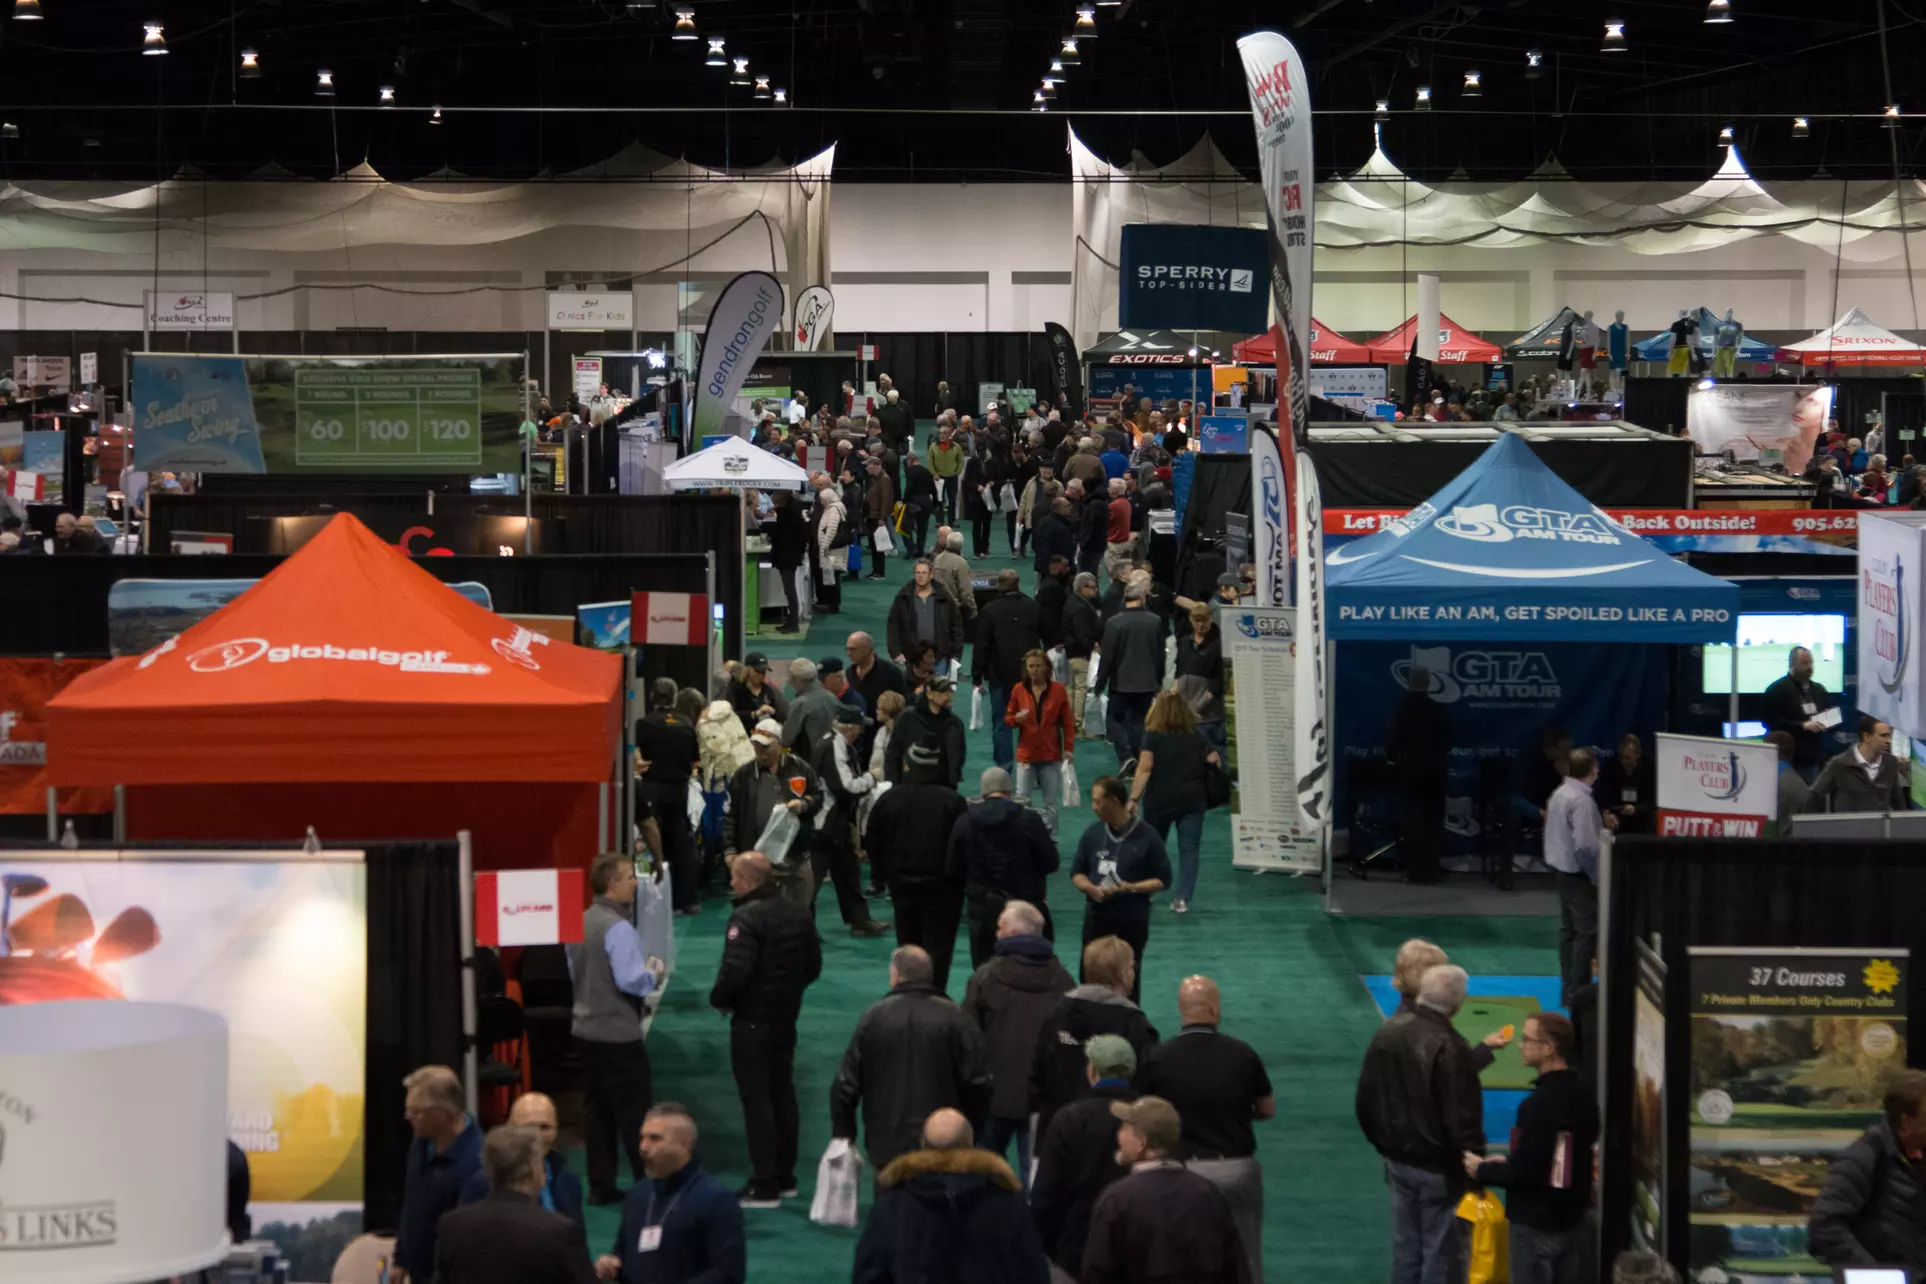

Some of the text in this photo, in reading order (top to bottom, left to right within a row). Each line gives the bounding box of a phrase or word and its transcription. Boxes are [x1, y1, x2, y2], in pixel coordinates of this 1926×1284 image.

[1138, 265, 1229, 280] SPERRY
[1138, 280, 1226, 291] TOP-SIDER
[150, 314, 232, 323] Coaching Centre
[556, 312, 585, 320] Clnics
[606, 312, 625, 320] Kids
[708, 286, 773, 398] gendrongolf
[1831, 335, 1897, 346] SRIXON
[1108, 354, 1185, 364] EXOTICS
[1440, 350, 1468, 362] Staff
[1343, 514, 1375, 529] Let
[1622, 514, 1673, 530] Back
[1674, 514, 1756, 530] Outside!
[1500, 505, 1613, 536] GTA
[1513, 527, 1621, 545] AM TOUR
[1339, 605, 1729, 622] PLAY LIKE AN AM, GET SPOILED LIKE A PRO
[1256, 616, 1291, 631] GTA
[267, 643, 449, 667] globalgolf
[1453, 650, 1560, 683] GTA
[1462, 685, 1561, 698] AM TOUR
[1684, 755, 1729, 774] PLAYERS
[1700, 773, 1729, 790] CLUB
[1750, 967, 1772, 986] 37
[1776, 968, 1846, 988] Courses
[1711, 994, 1746, 1006] Private
[16, 1208, 117, 1242] LINKS
